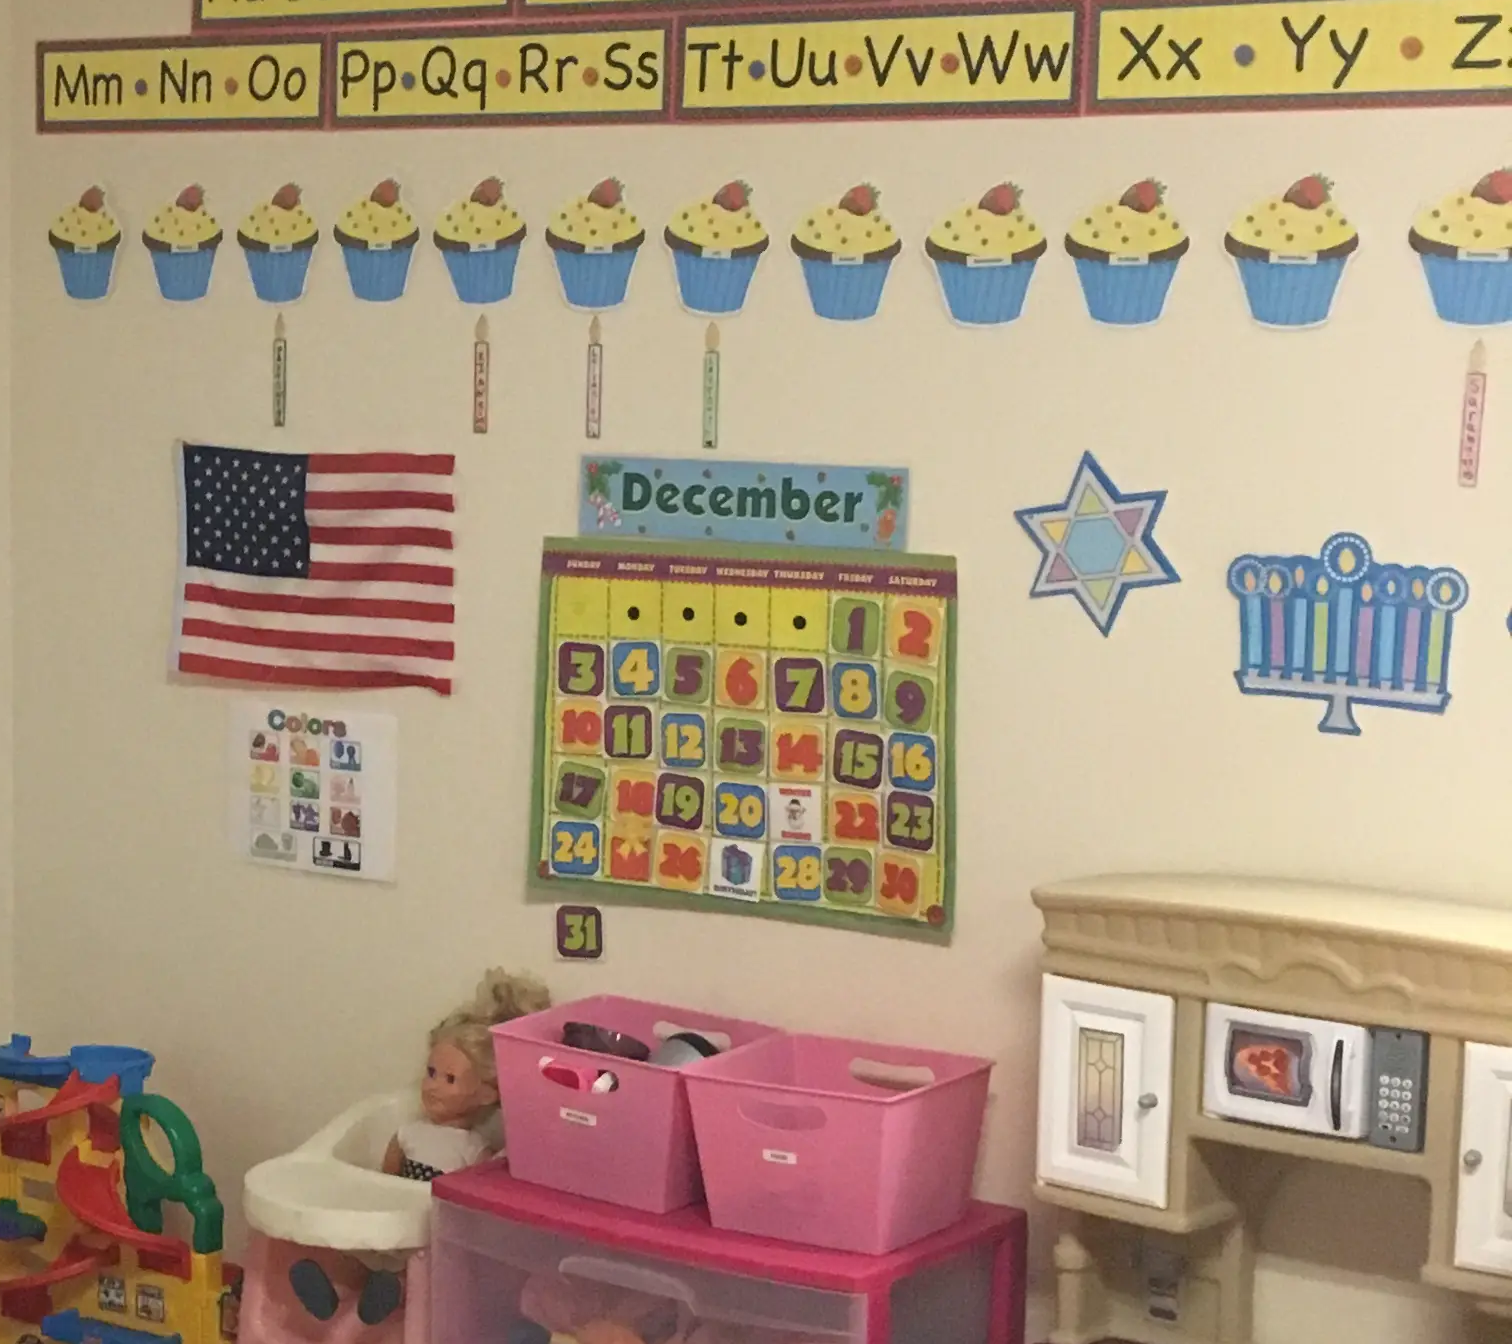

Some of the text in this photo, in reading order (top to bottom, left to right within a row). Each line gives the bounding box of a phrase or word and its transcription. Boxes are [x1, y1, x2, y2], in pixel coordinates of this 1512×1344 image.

[340, 40, 658, 112] Pp Qq Rr Ss
[687, 29, 1069, 93] Tt Uu Vv Ww
[1117, 13, 1512, 89] Xx Yy Z
[54, 54, 306, 107] Mm Nn Oo
[621, 471, 865, 524] December
[566, 558, 938, 588] SUNDAY MONDAY TUESDAY WEDNESDAY THURSDAY FRIDAY SATURDAY
[847, 606, 933, 658] 1 2
[567, 648, 927, 725] 3 4 5 6 7 8 9
[267, 708, 347, 738] Colors
[561, 708, 933, 783] 10 11 12 13 14 15 16
[559, 771, 602, 808] 17
[661, 782, 701, 823] 19
[719, 792, 763, 829] 20
[834, 799, 932, 842] 22 23
[554, 830, 918, 905] 24 26 28 29 30
[563, 913, 597, 952] 31
